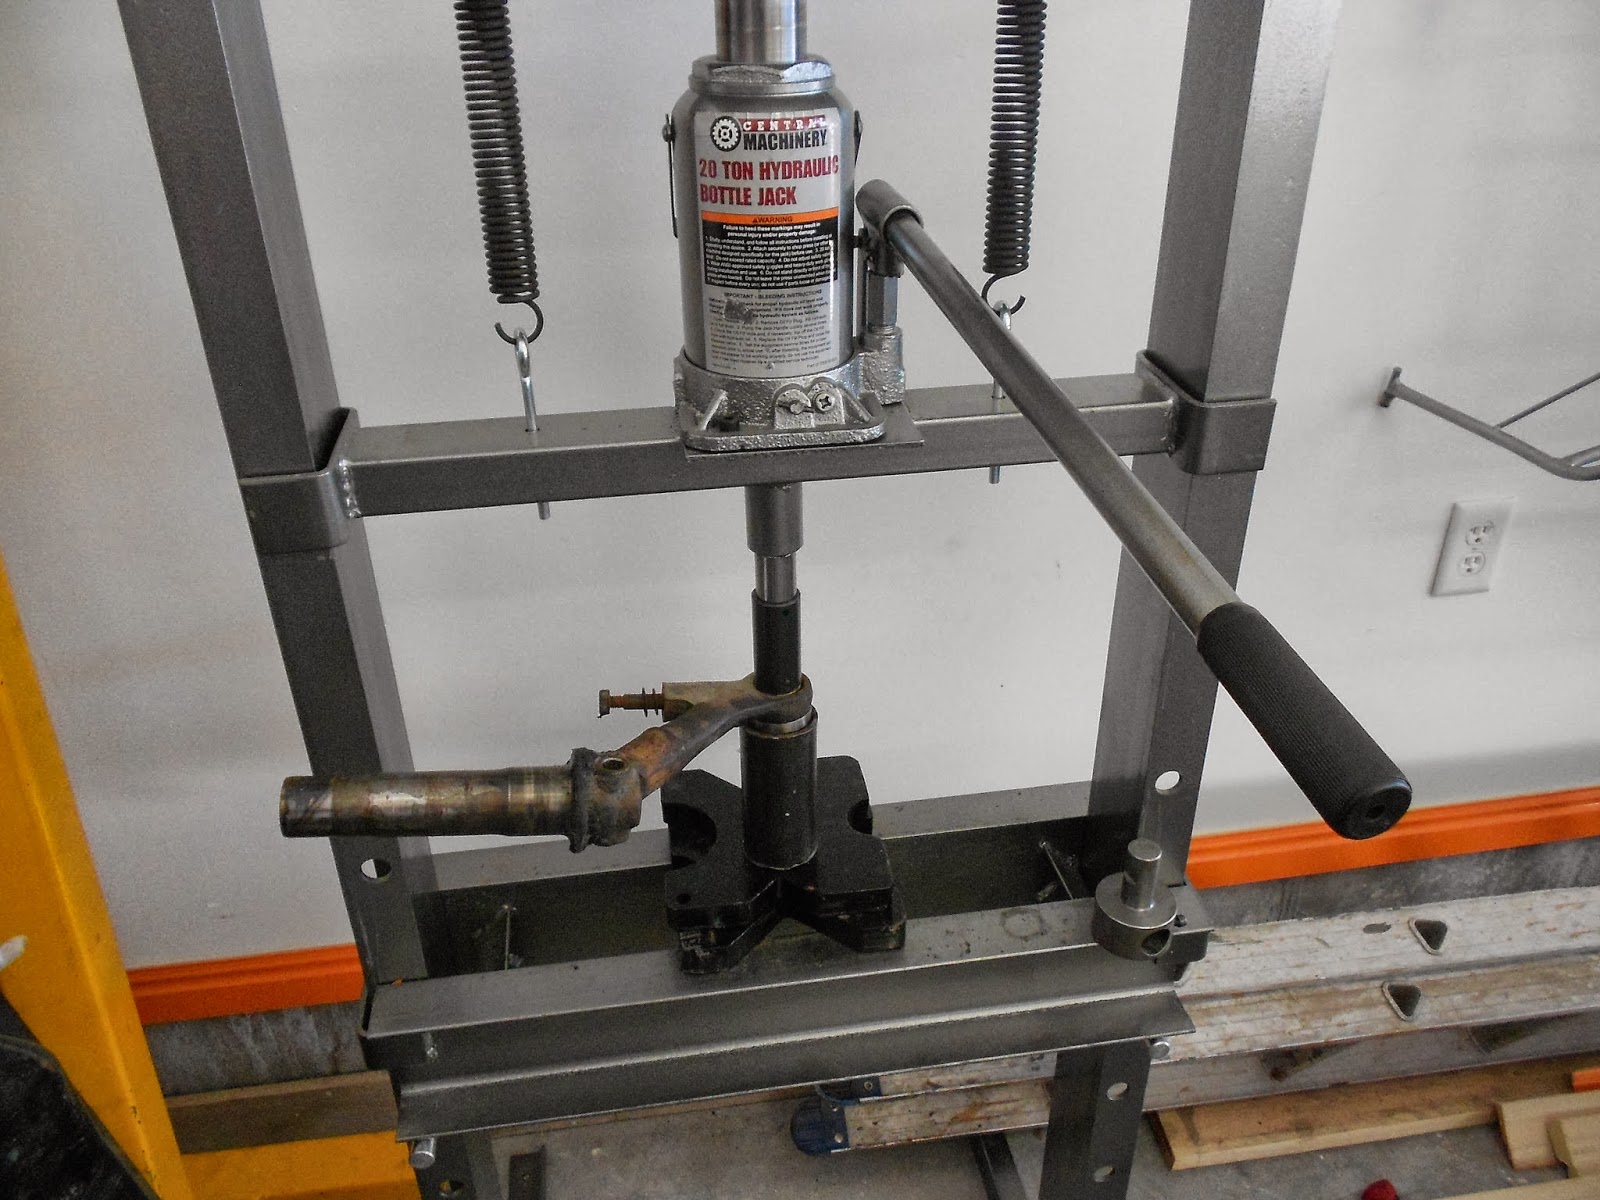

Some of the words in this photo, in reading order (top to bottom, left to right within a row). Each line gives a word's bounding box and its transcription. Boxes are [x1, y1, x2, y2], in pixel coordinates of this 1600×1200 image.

[743, 129, 828, 150] MACHINERY
[699, 160, 717, 179] 20
[722, 161, 753, 180] TON
[759, 155, 839, 180] HYDRAULIC
[700, 184, 752, 206] BOTTLE
[757, 186, 797, 206] JACK
